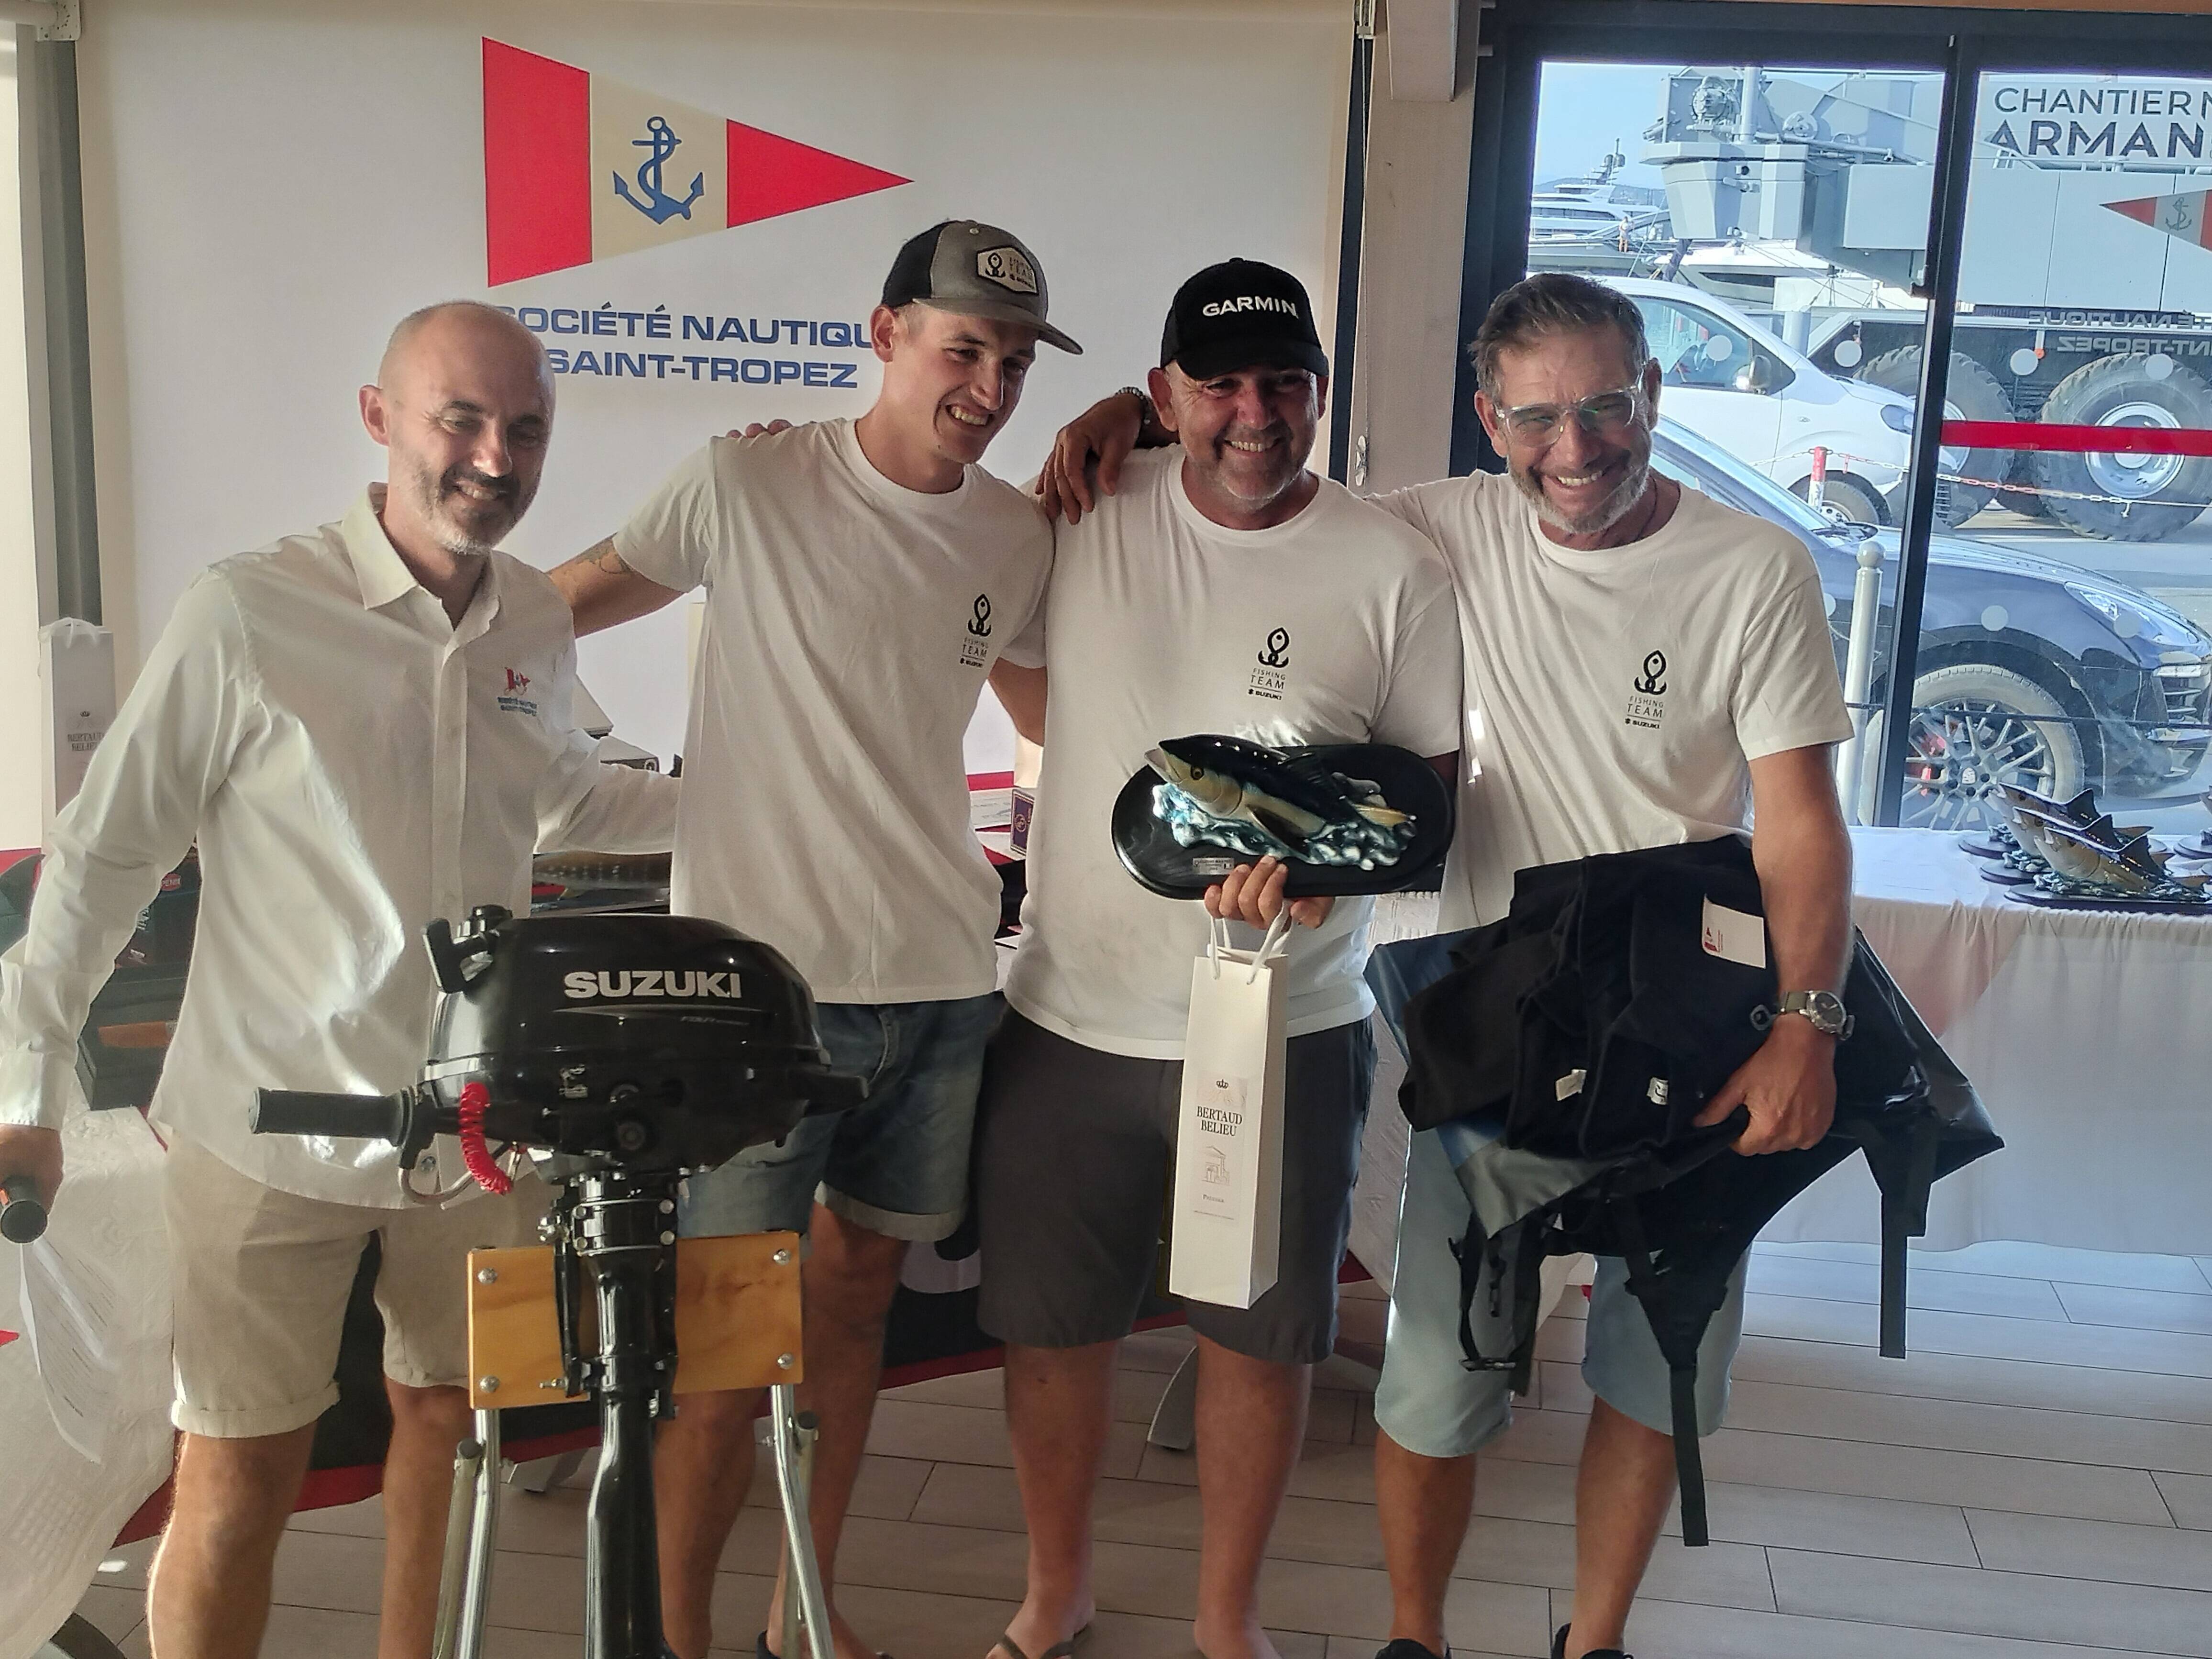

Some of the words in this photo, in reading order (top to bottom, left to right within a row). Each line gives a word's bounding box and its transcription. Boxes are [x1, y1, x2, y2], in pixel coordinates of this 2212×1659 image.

[1994, 88, 2191, 115] CHANTIER
[1986, 119, 2204, 158] ARMAN
[1202, 296, 1299, 319] GARMIN
[495, 301, 671, 338] OCIÉTÉ
[546, 349, 857, 388] SAINT-TROPEZ
[962, 644, 987, 657] TEAM
[1251, 675, 1284, 689] TEAM
[1253, 668, 1286, 680] FISHING
[1627, 703, 1663, 718] TEAM
[1629, 696, 1664, 708] FISHING
[564, 971, 742, 998] SUZUKI
[1196, 1106, 1243, 1125] BERTAUD
[1201, 1120, 1237, 1137] BELIEU
